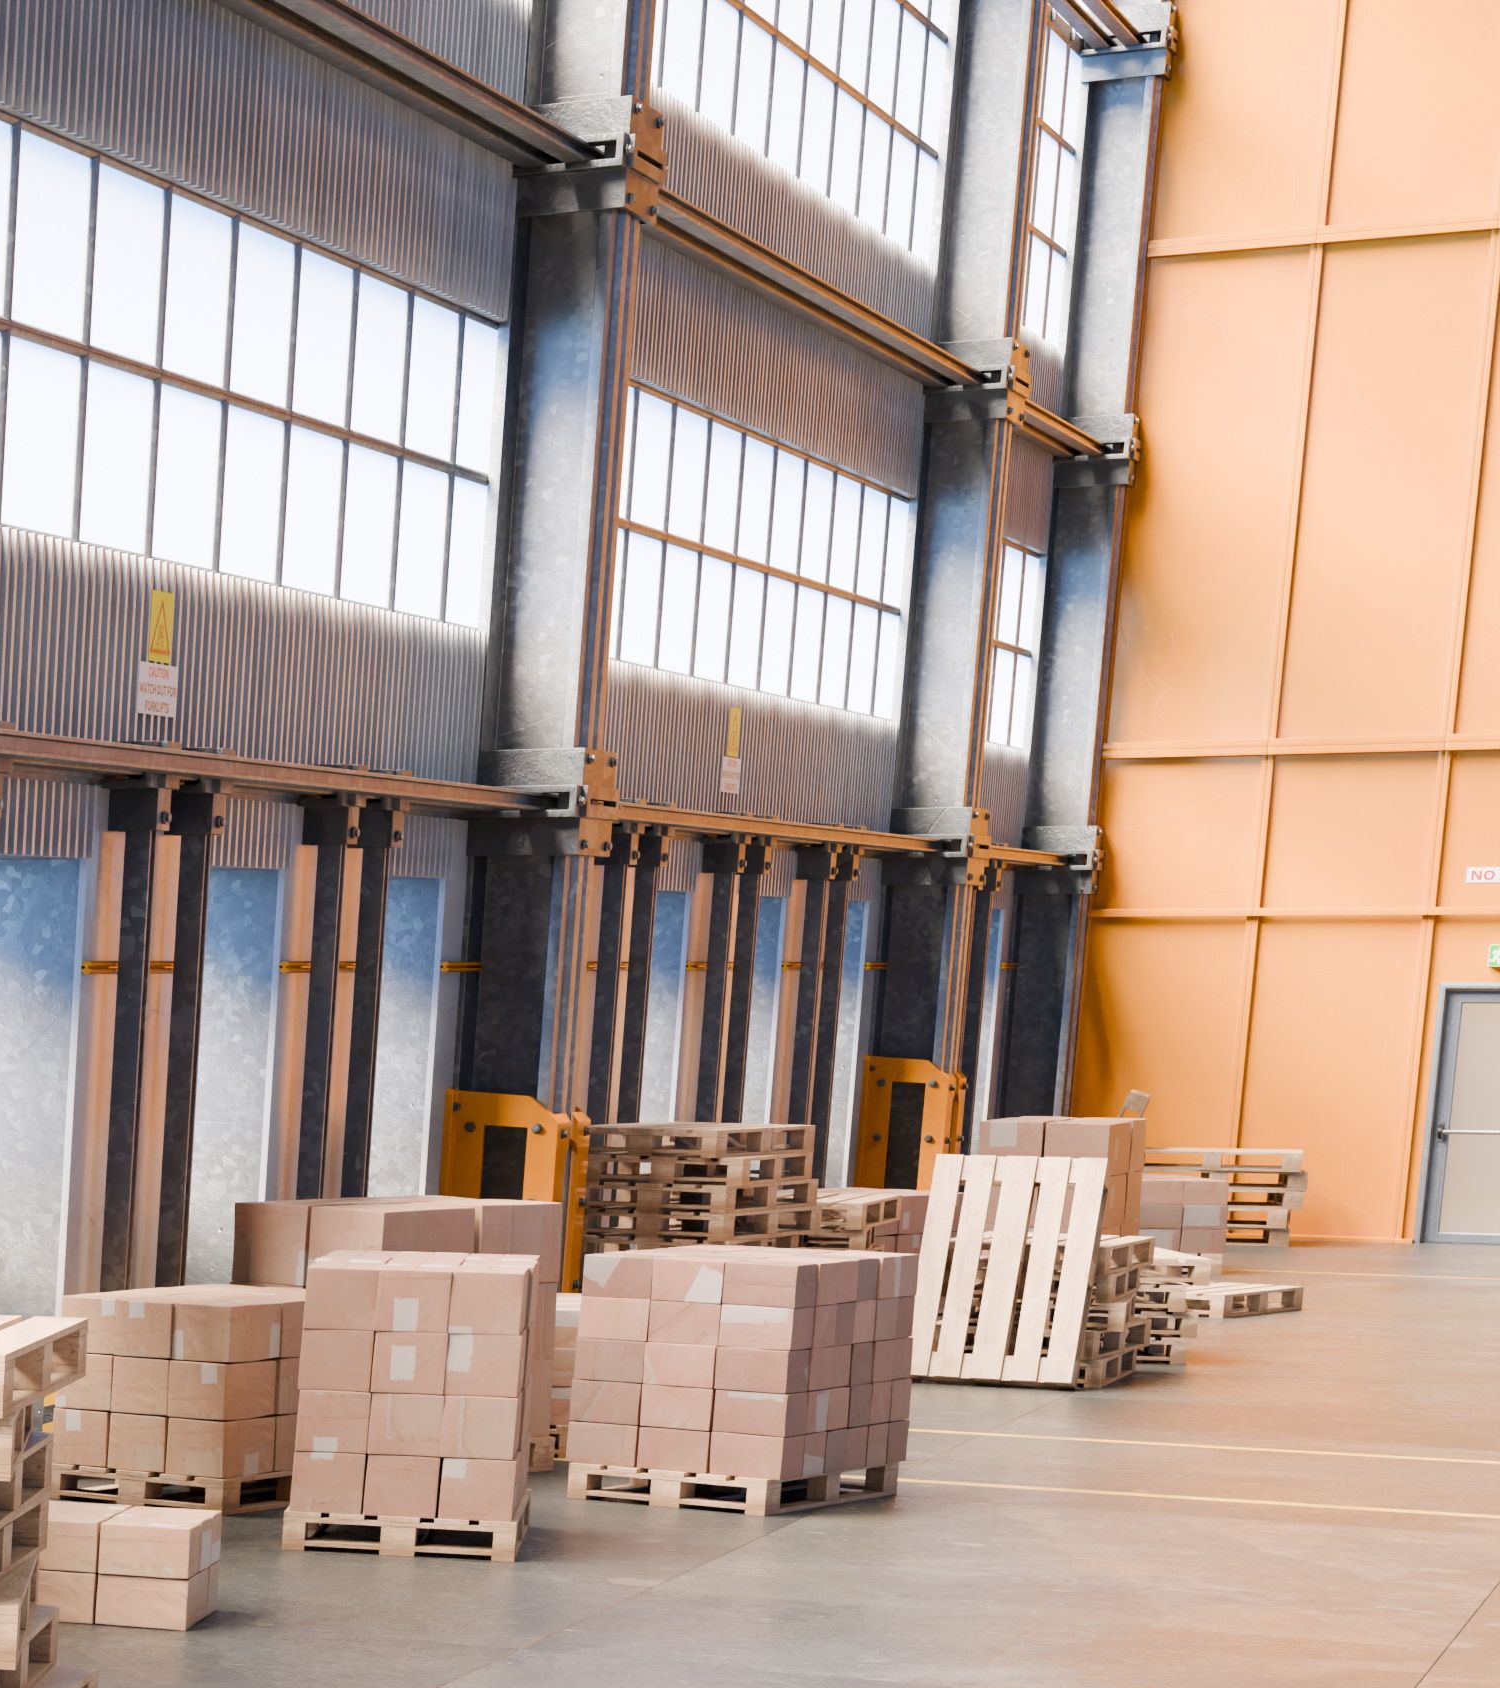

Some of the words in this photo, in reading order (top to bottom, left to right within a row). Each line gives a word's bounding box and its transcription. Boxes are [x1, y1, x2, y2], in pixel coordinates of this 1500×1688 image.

[148, 666, 169, 679] CAUTION
[139, 683, 157, 695] WATCH
[145, 700, 169, 713] FORKLIFTS
[1471, 870, 1496, 880] NO
